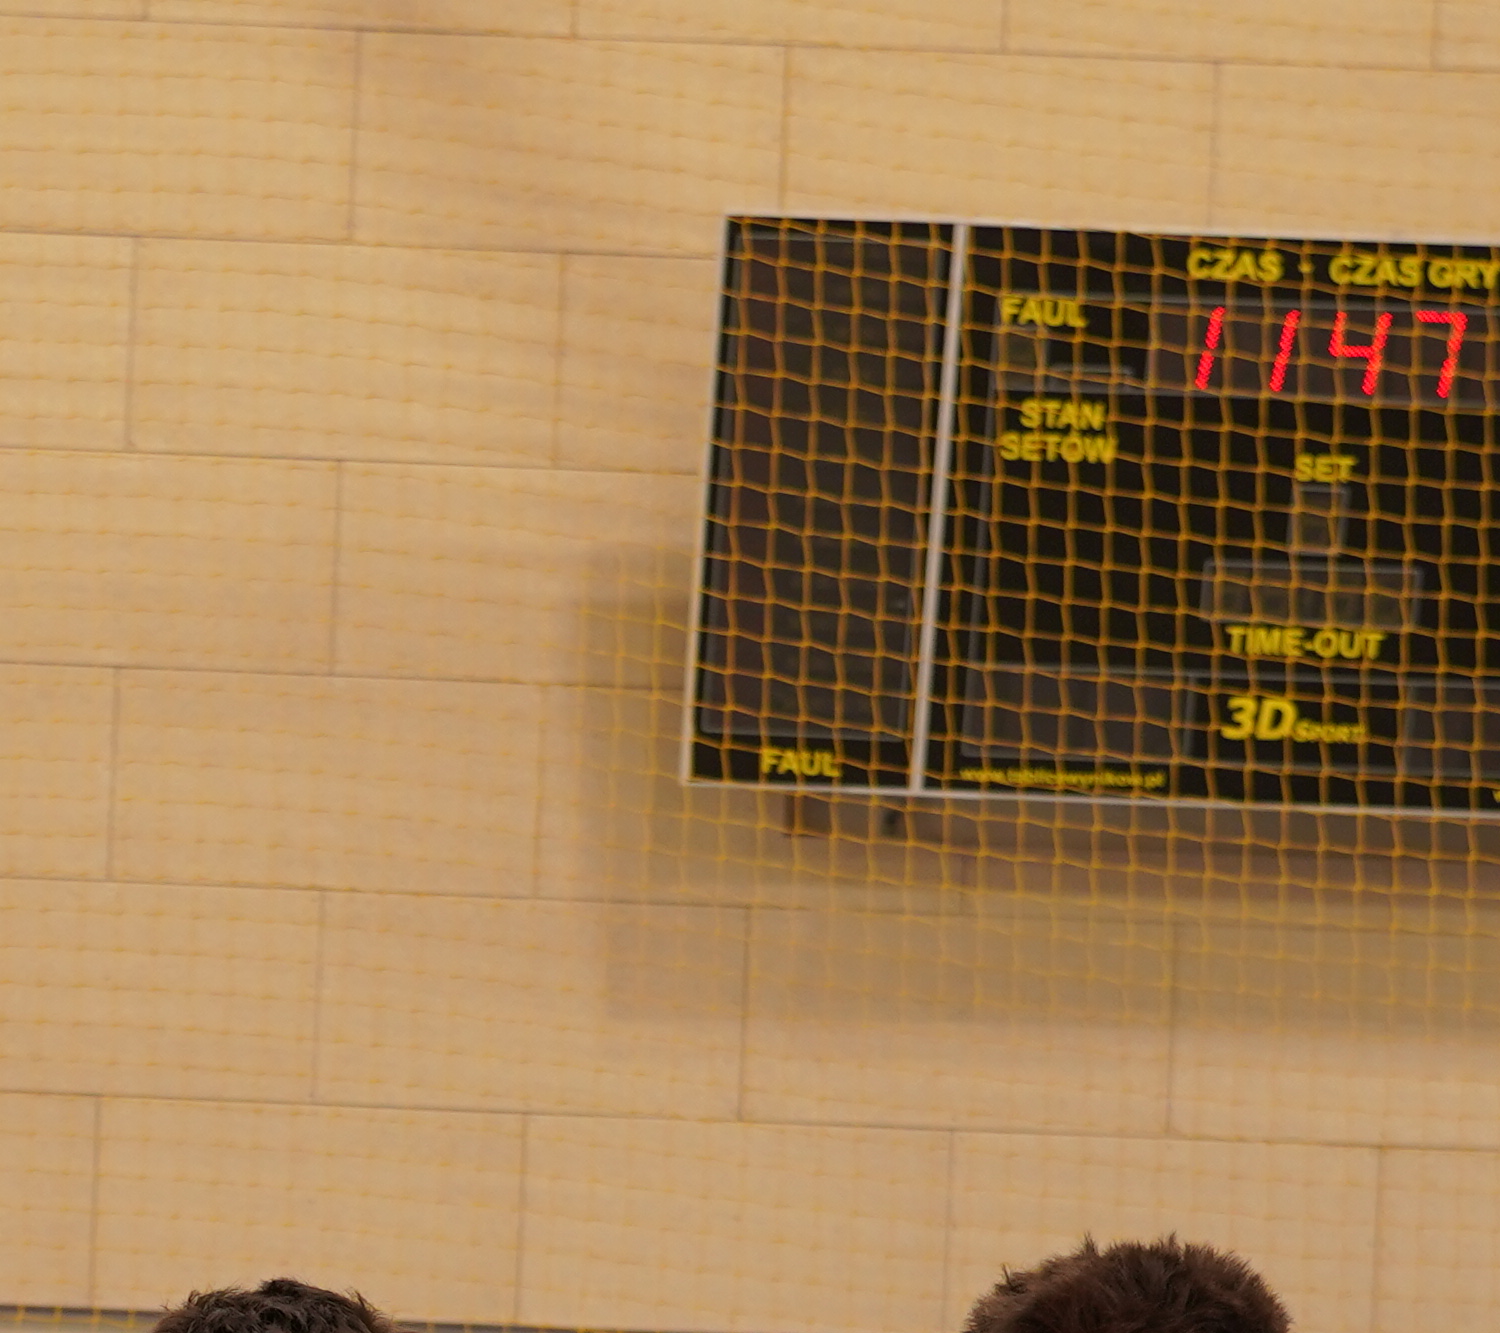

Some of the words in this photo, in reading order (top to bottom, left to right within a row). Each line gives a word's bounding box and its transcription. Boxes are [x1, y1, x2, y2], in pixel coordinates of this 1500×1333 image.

[1187, 248, 1285, 282] CZAS
[1328, 254, 1422, 287] CZAS
[1427, 260, 1500, 289] GRY
[1000, 294, 1087, 328] FAUL
[1020, 399, 1106, 431] STAN
[1294, 452, 1358, 483] SET
[1225, 625, 1387, 660] TIME-OUT
[760, 747, 842, 778] FAUL
